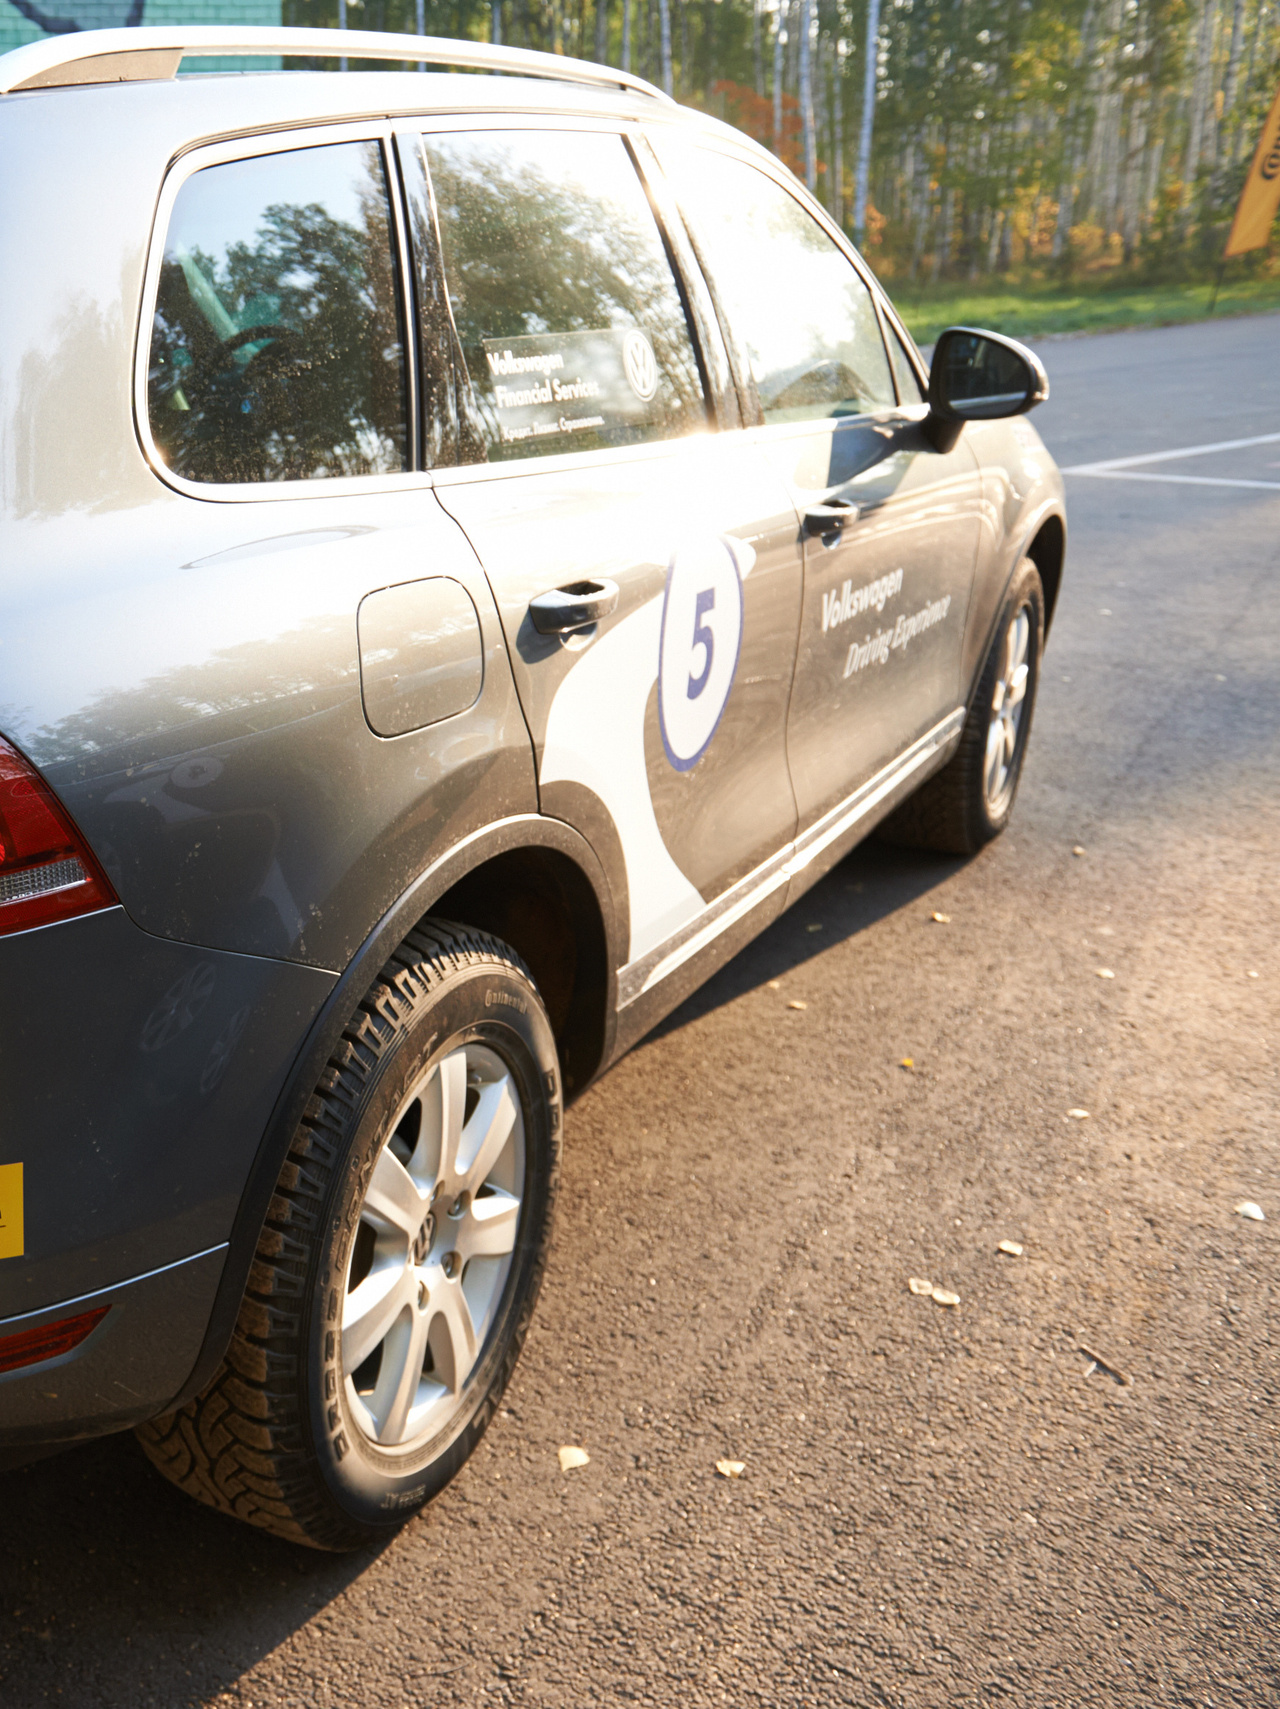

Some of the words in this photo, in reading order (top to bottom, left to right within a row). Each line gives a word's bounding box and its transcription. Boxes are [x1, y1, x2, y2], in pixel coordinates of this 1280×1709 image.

[486, 350, 564, 376] Volkswagen
[494, 378, 554, 408] Financial
[552, 377, 600, 401] Services
[821, 567, 904, 633] Volkswagen
[686, 587, 716, 701] 5
[842, 628, 894, 679] Driving
[889, 594, 952, 650] Experience
